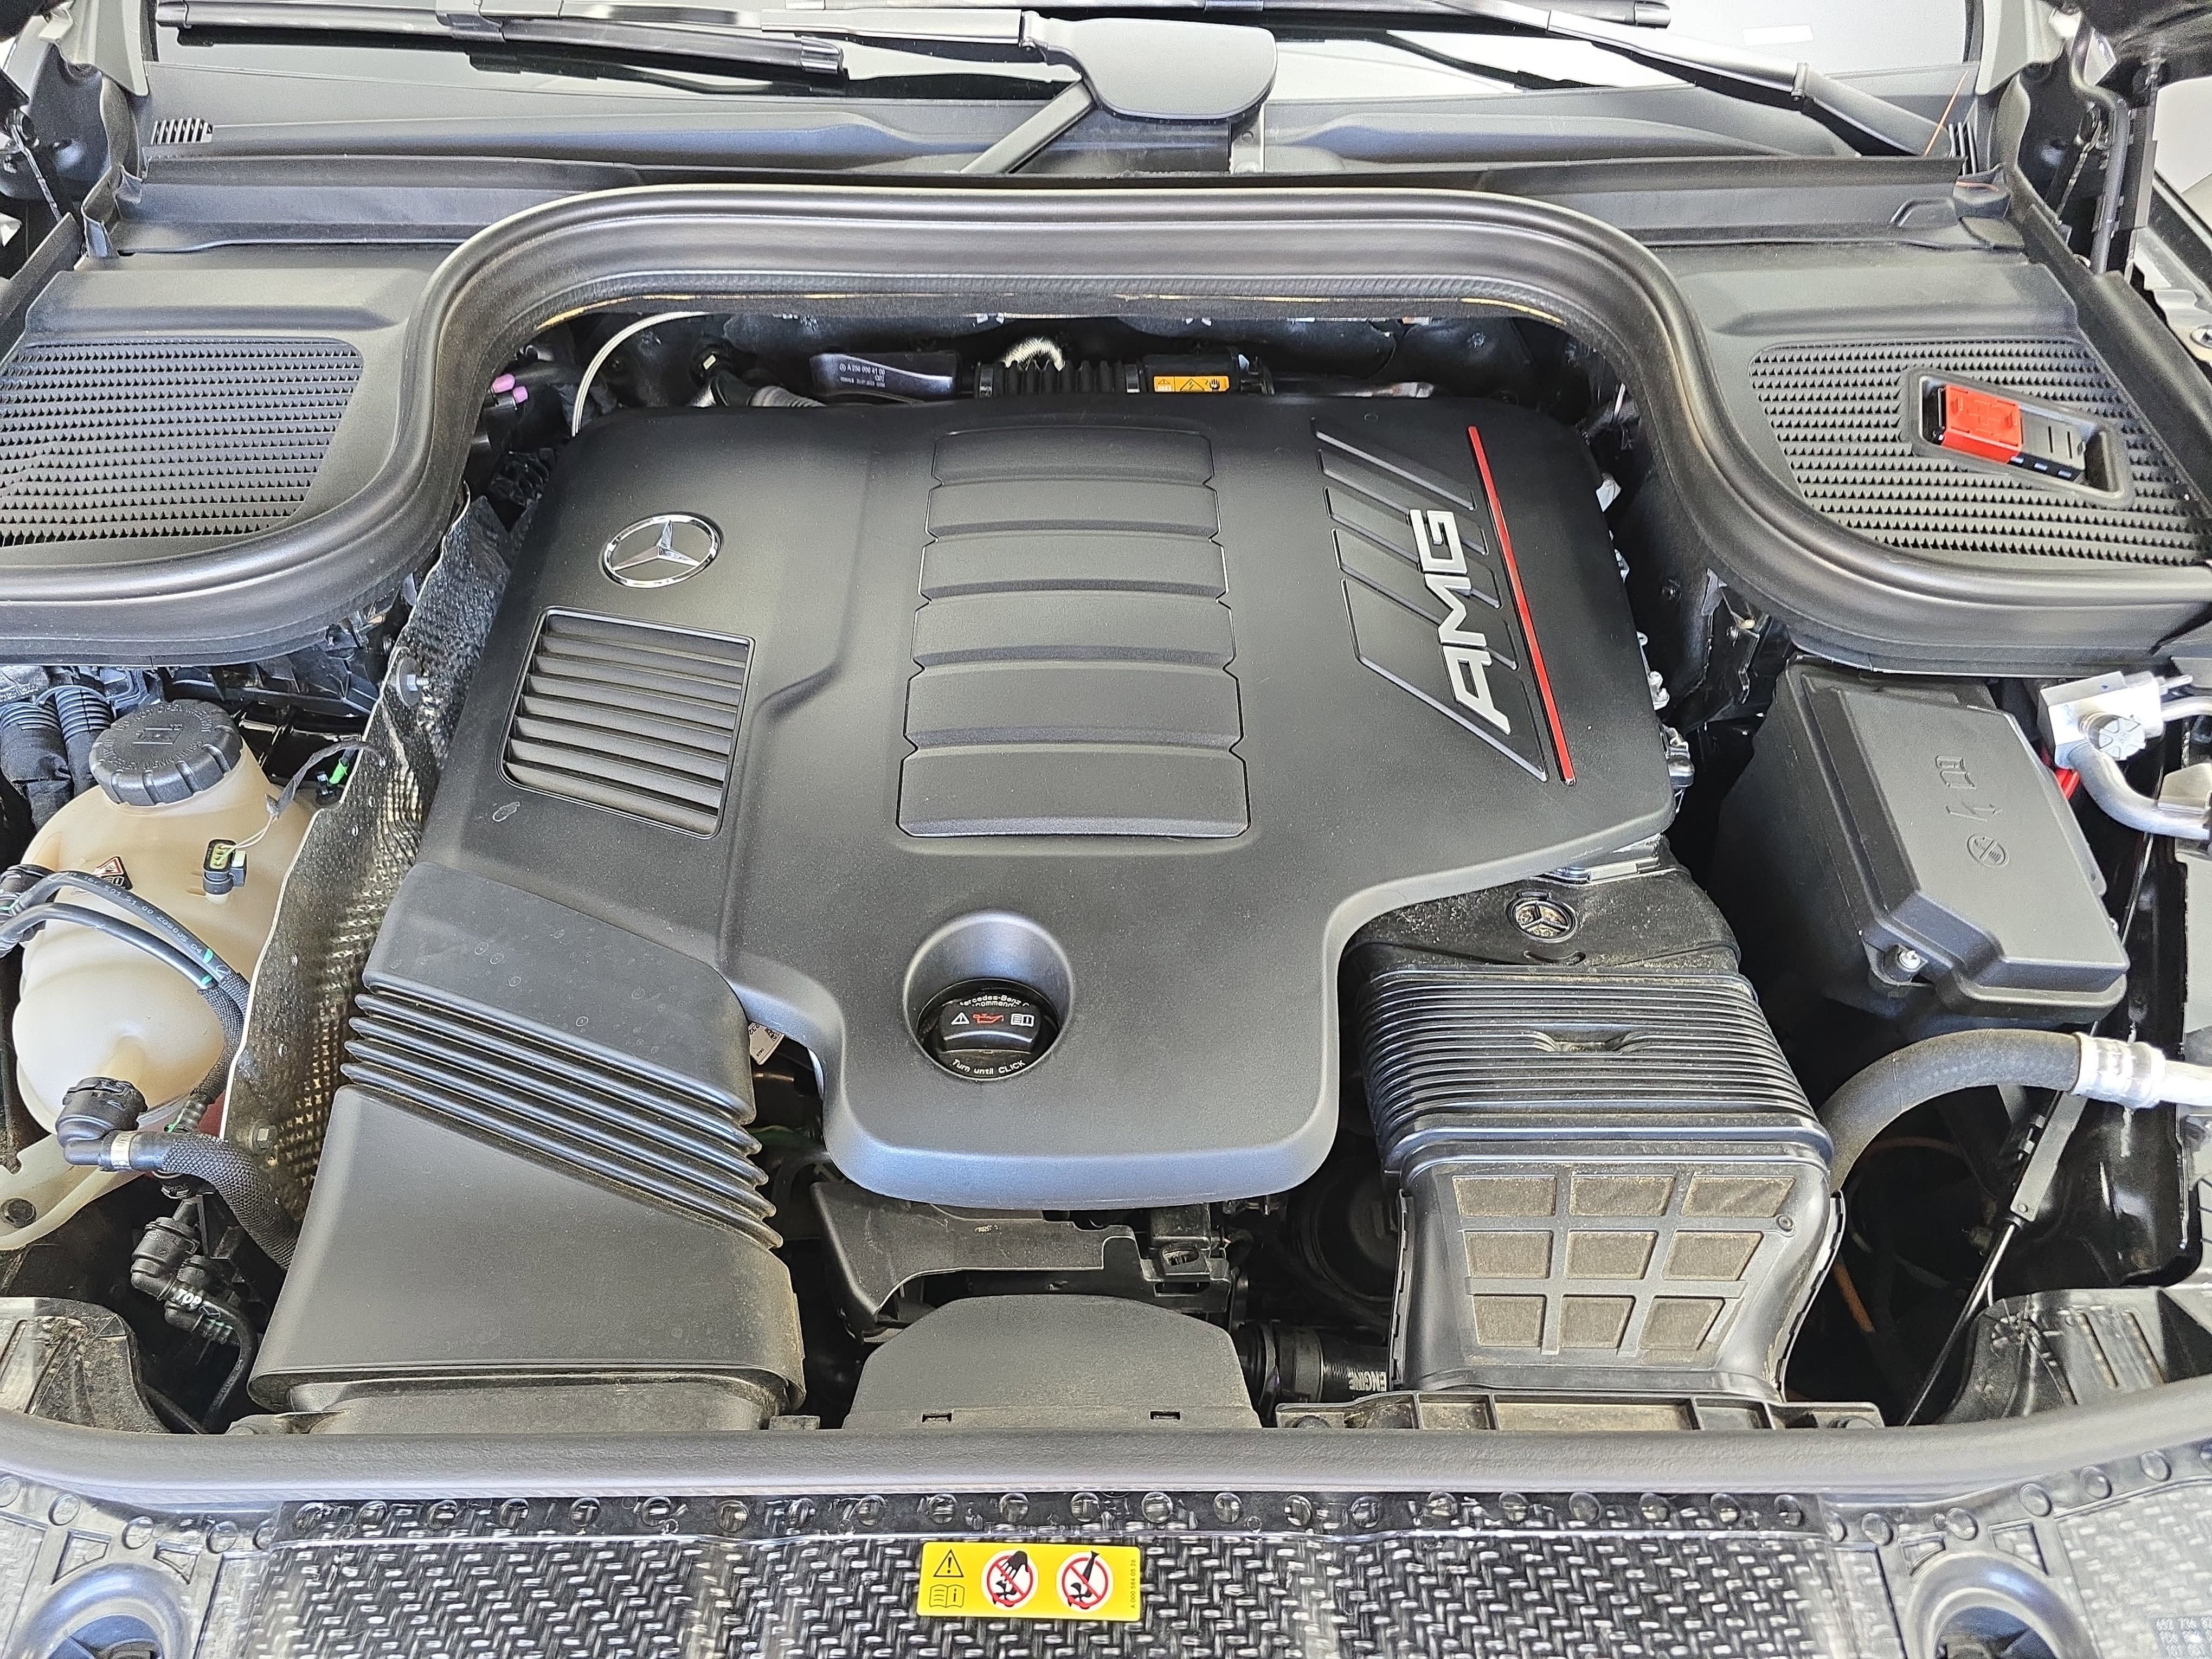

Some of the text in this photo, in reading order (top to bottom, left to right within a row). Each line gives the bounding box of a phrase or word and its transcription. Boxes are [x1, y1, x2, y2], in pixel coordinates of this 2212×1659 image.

[1407, 508, 1511, 735] AMG
[142, 906, 153, 915] 00
[952, 1058, 1026, 1075] Turn until CLICK
[175, 1288, 203, 1311] TOP
[1348, 1371, 1386, 1392] ENGINE
[1130, 1568, 1136, 1577] 05
